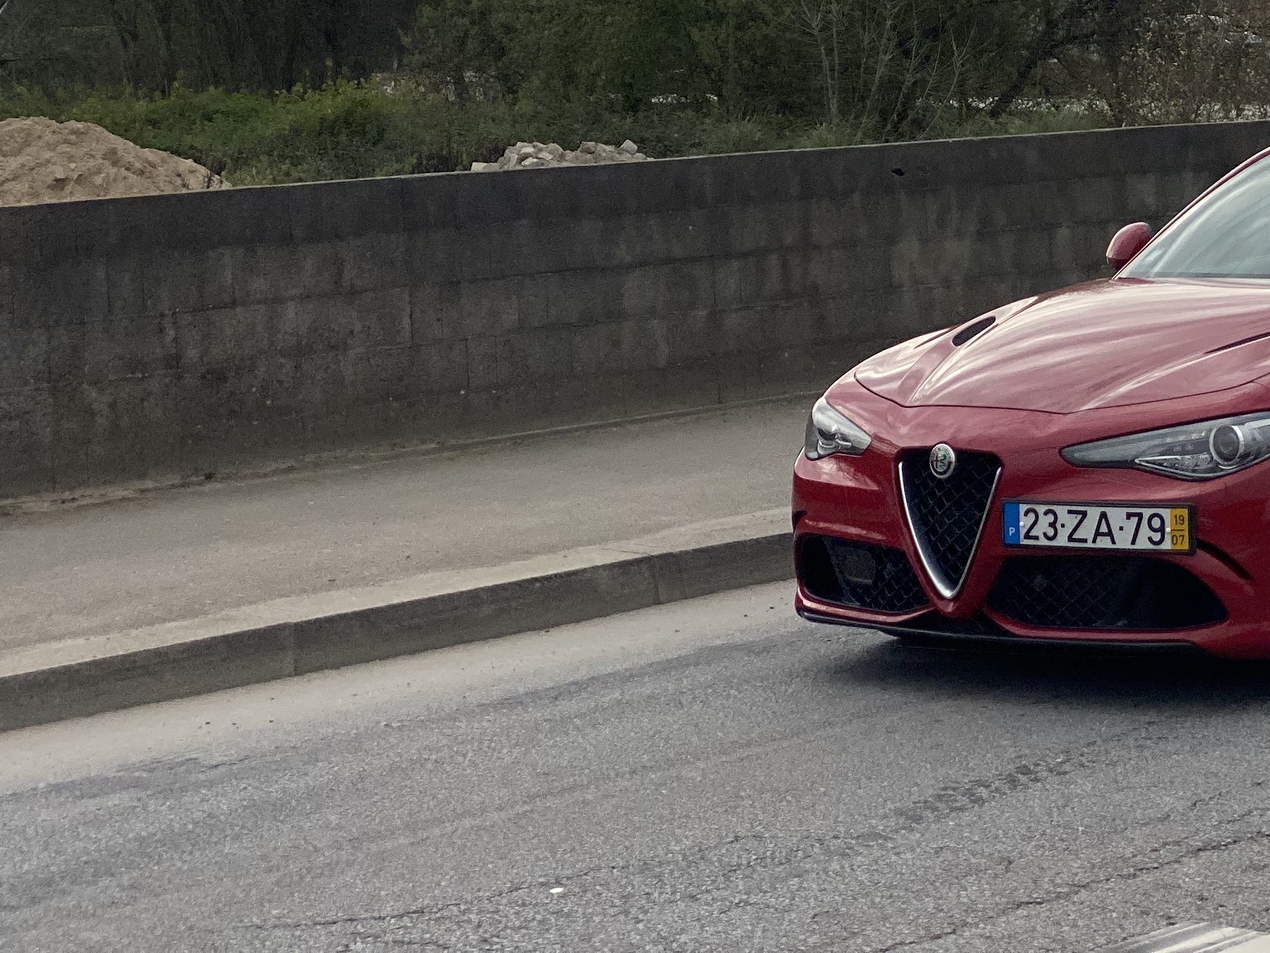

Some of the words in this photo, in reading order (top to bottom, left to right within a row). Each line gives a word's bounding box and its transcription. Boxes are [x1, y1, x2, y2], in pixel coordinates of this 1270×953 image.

[1173, 514, 1185, 526] 19
[1008, 527, 1016, 536] P
[1171, 534, 1185, 546] 07
